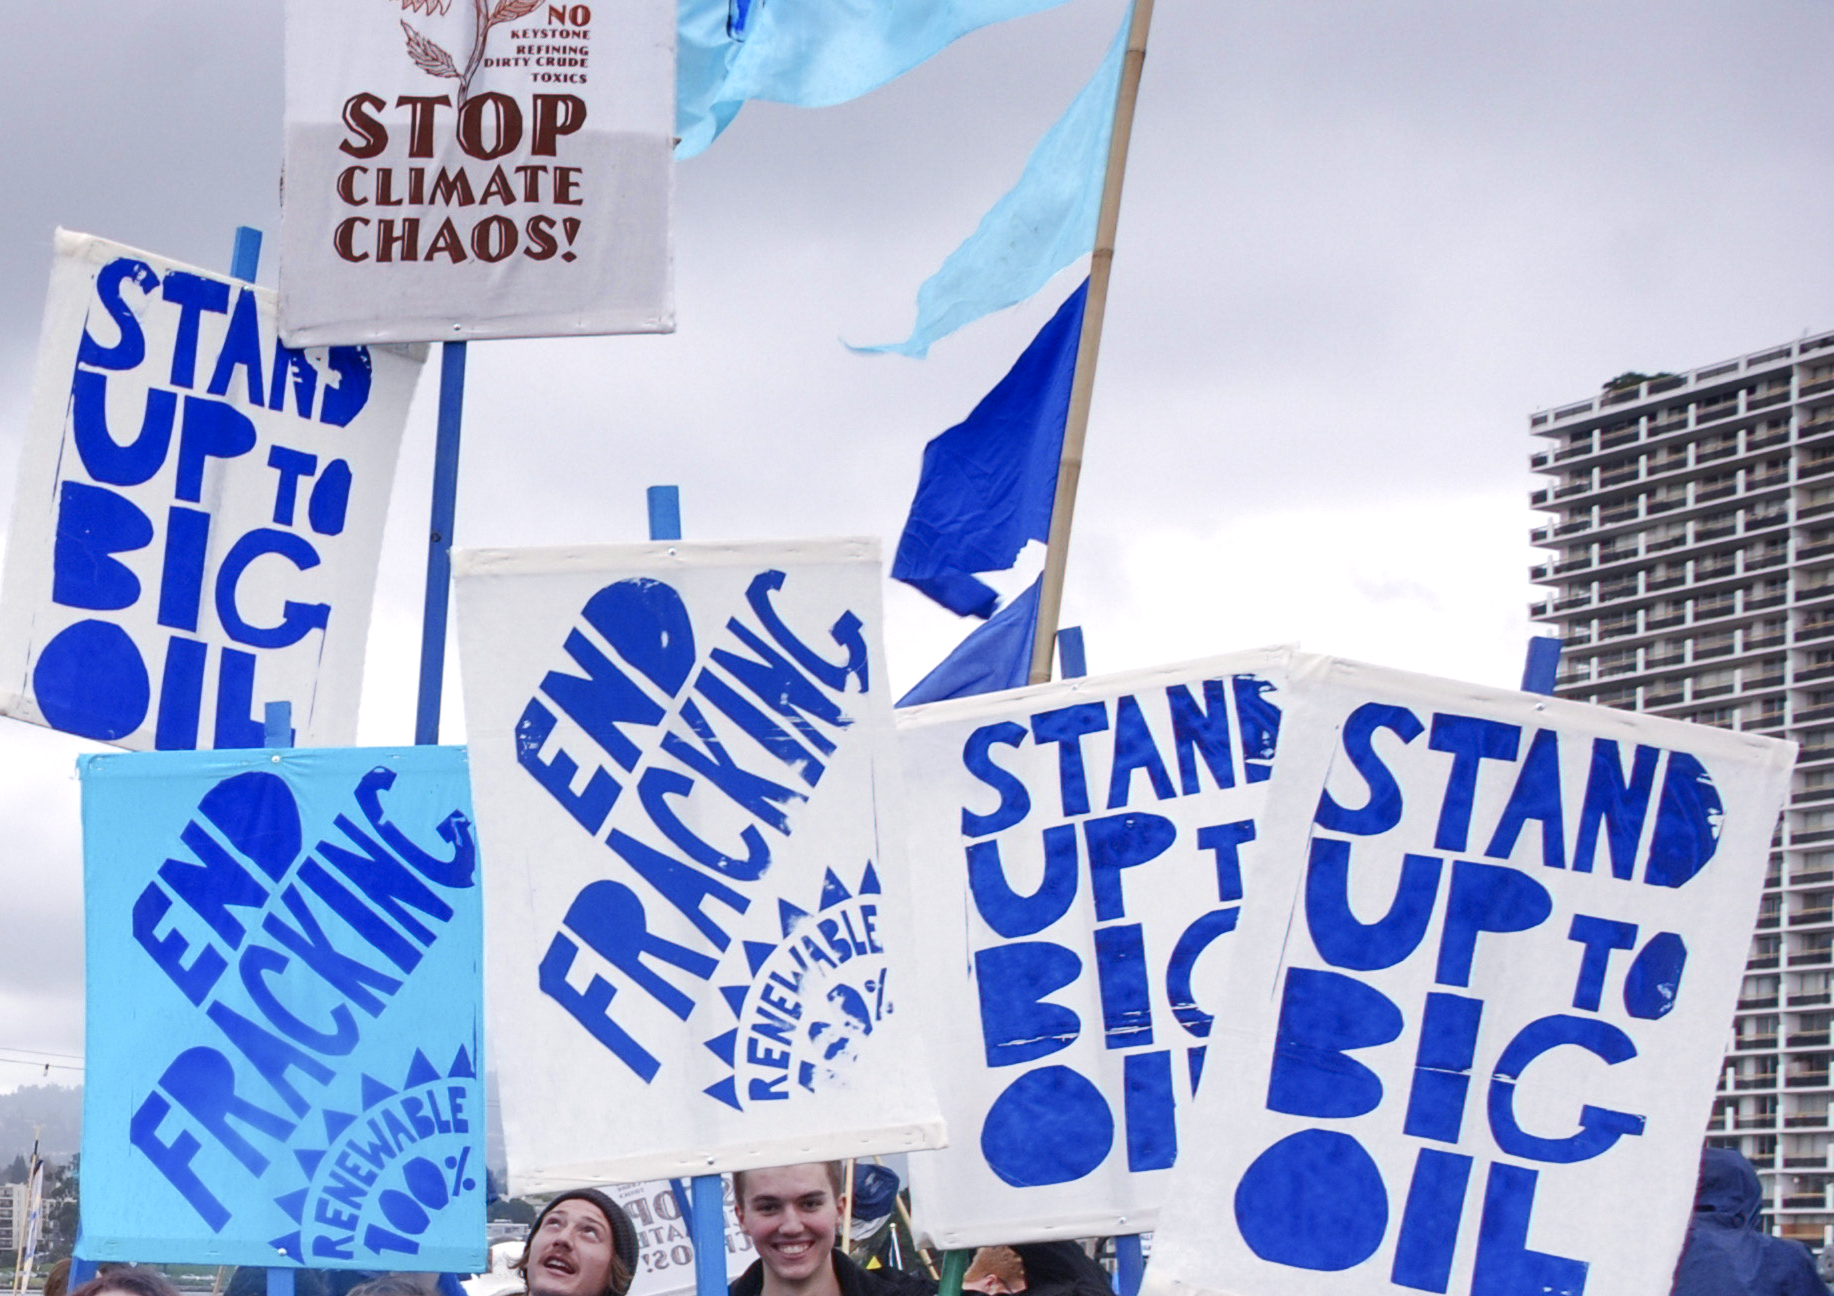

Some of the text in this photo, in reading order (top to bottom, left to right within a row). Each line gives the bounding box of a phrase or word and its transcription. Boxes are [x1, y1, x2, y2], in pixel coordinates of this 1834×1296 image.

[484, 56, 589, 69] DIRTY CRUDE
[511, 28, 591, 41] KEYSTONE
[516, 44, 590, 57] REFINING
[530, 72, 588, 84] TOXICS
[548, 4, 591, 27] NO
[336, 164, 584, 207] CLIMATE
[338, 91, 588, 161] STOP
[333, 214, 582, 265] CHAOS!
[73, 370, 353, 536] UP TO
[52, 479, 332, 649] BIG
[33, 618, 297, 751] OIL
[514, 577, 697, 837] END
[962, 673, 1282, 838] STAND
[538, 569, 868, 1085] FRACKING
[1314, 702, 1725, 889] STAND
[132, 771, 303, 1008] END
[966, 811, 1256, 939] UP T
[1304, 838, 1687, 1020] UP TO
[130, 765, 476, 1234] FRACKING
[748, 904, 884, 1101] RENEWABLE
[1265, 967, 1647, 1164] BIG
[312, 1085, 469, 1261] RENEWABLE
[980, 1046, 1206, 1189] OI
[364, 1145, 476, 1256] 100%
